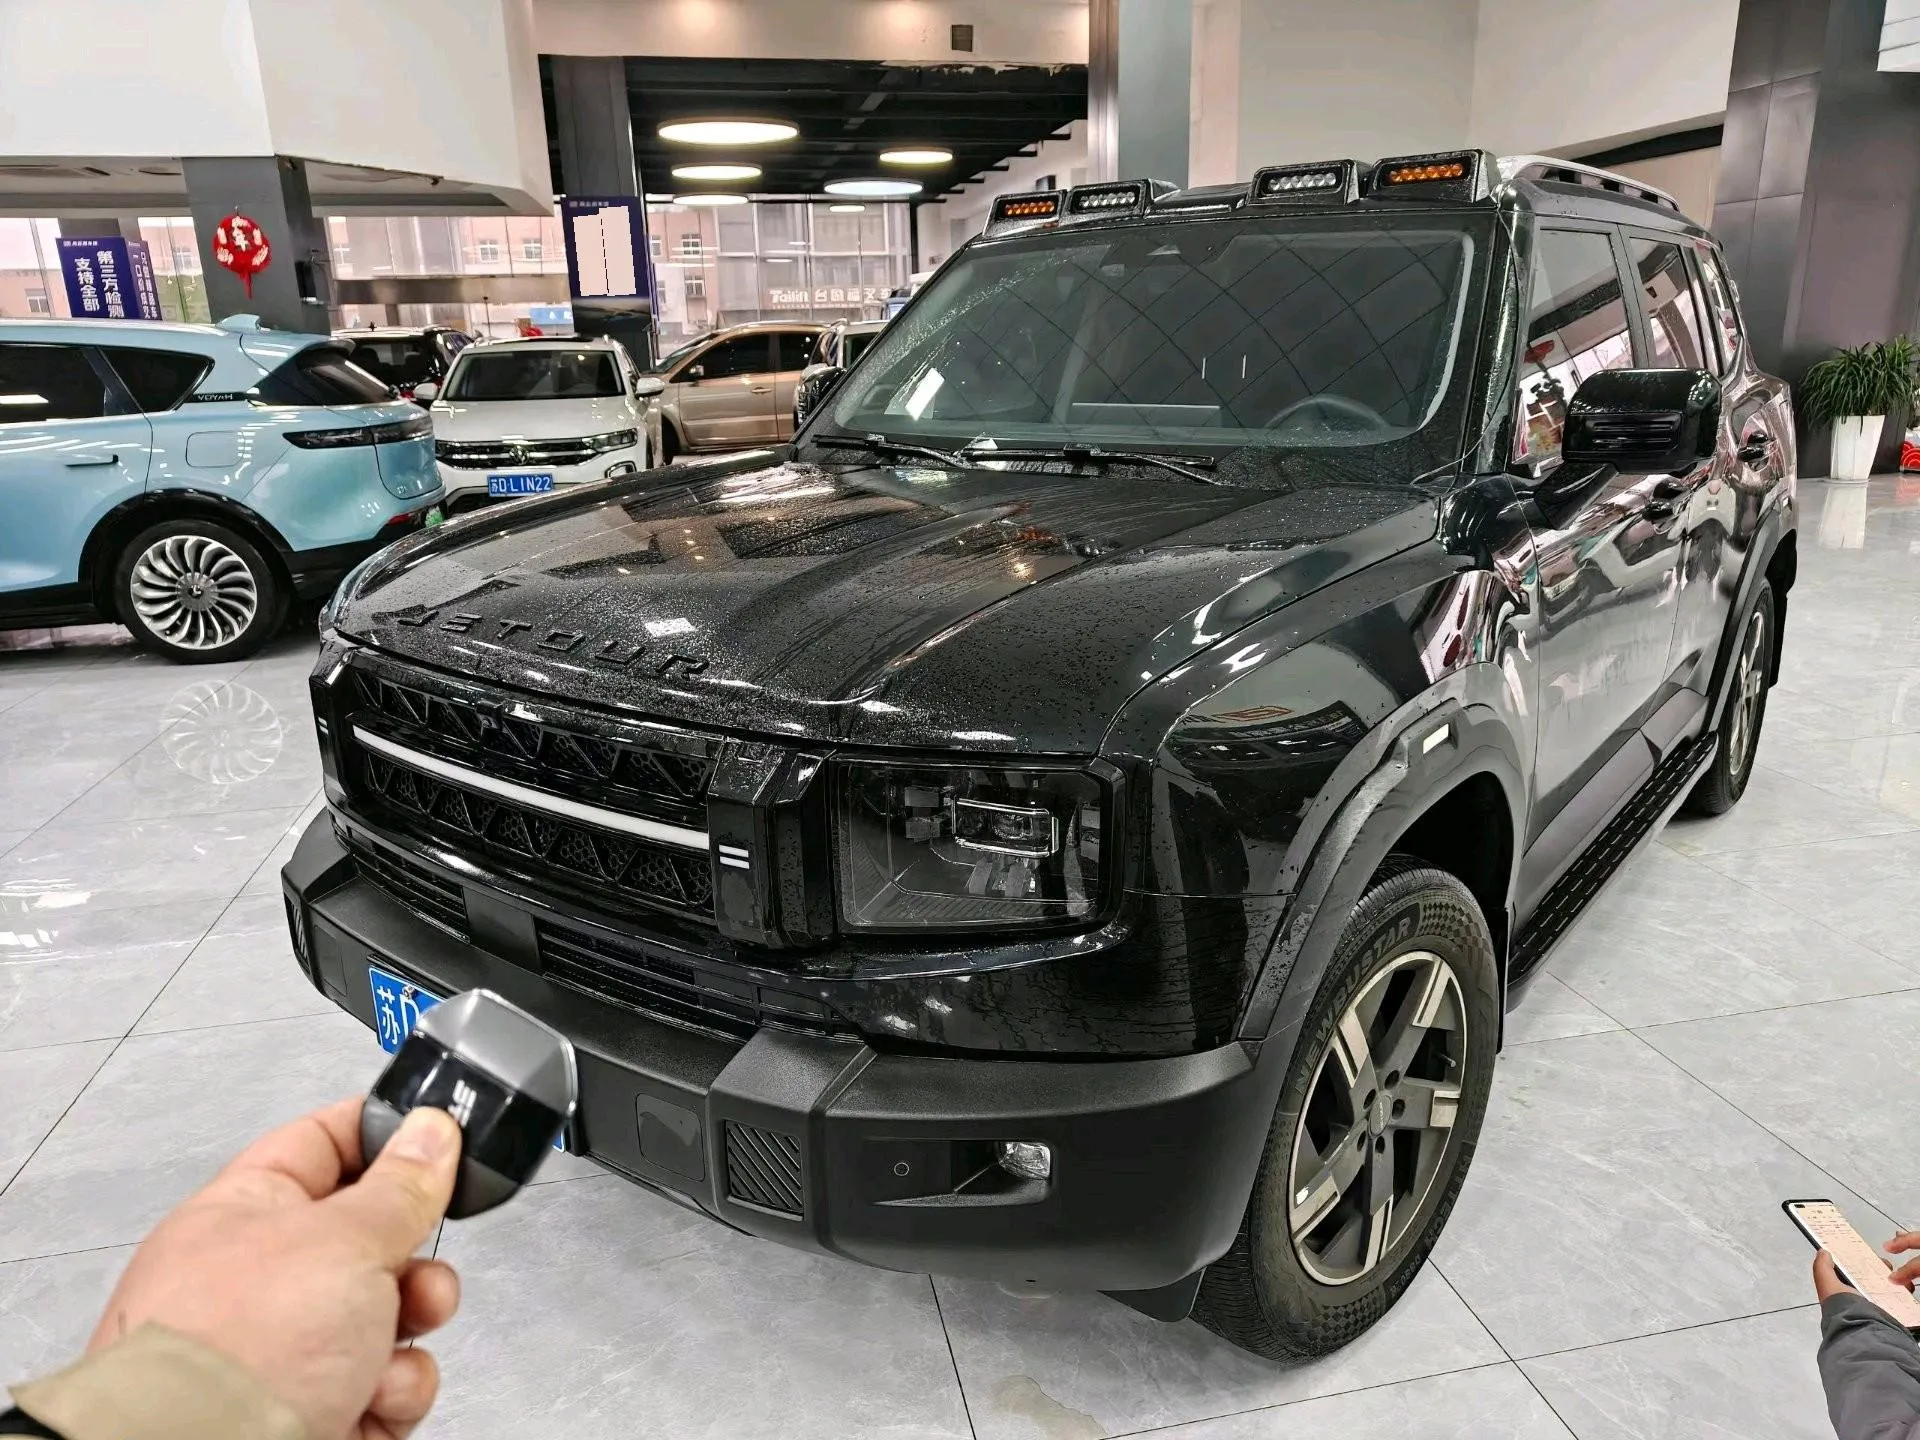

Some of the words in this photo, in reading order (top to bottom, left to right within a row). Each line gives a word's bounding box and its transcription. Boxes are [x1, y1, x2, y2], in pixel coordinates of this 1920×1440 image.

[74, 257, 100, 311] 支持全部
[97, 251, 125, 318] 第三方检测
[398, 610, 709, 681] JETOUR
[1295, 916, 1412, 1096] NEWBUSTAR
